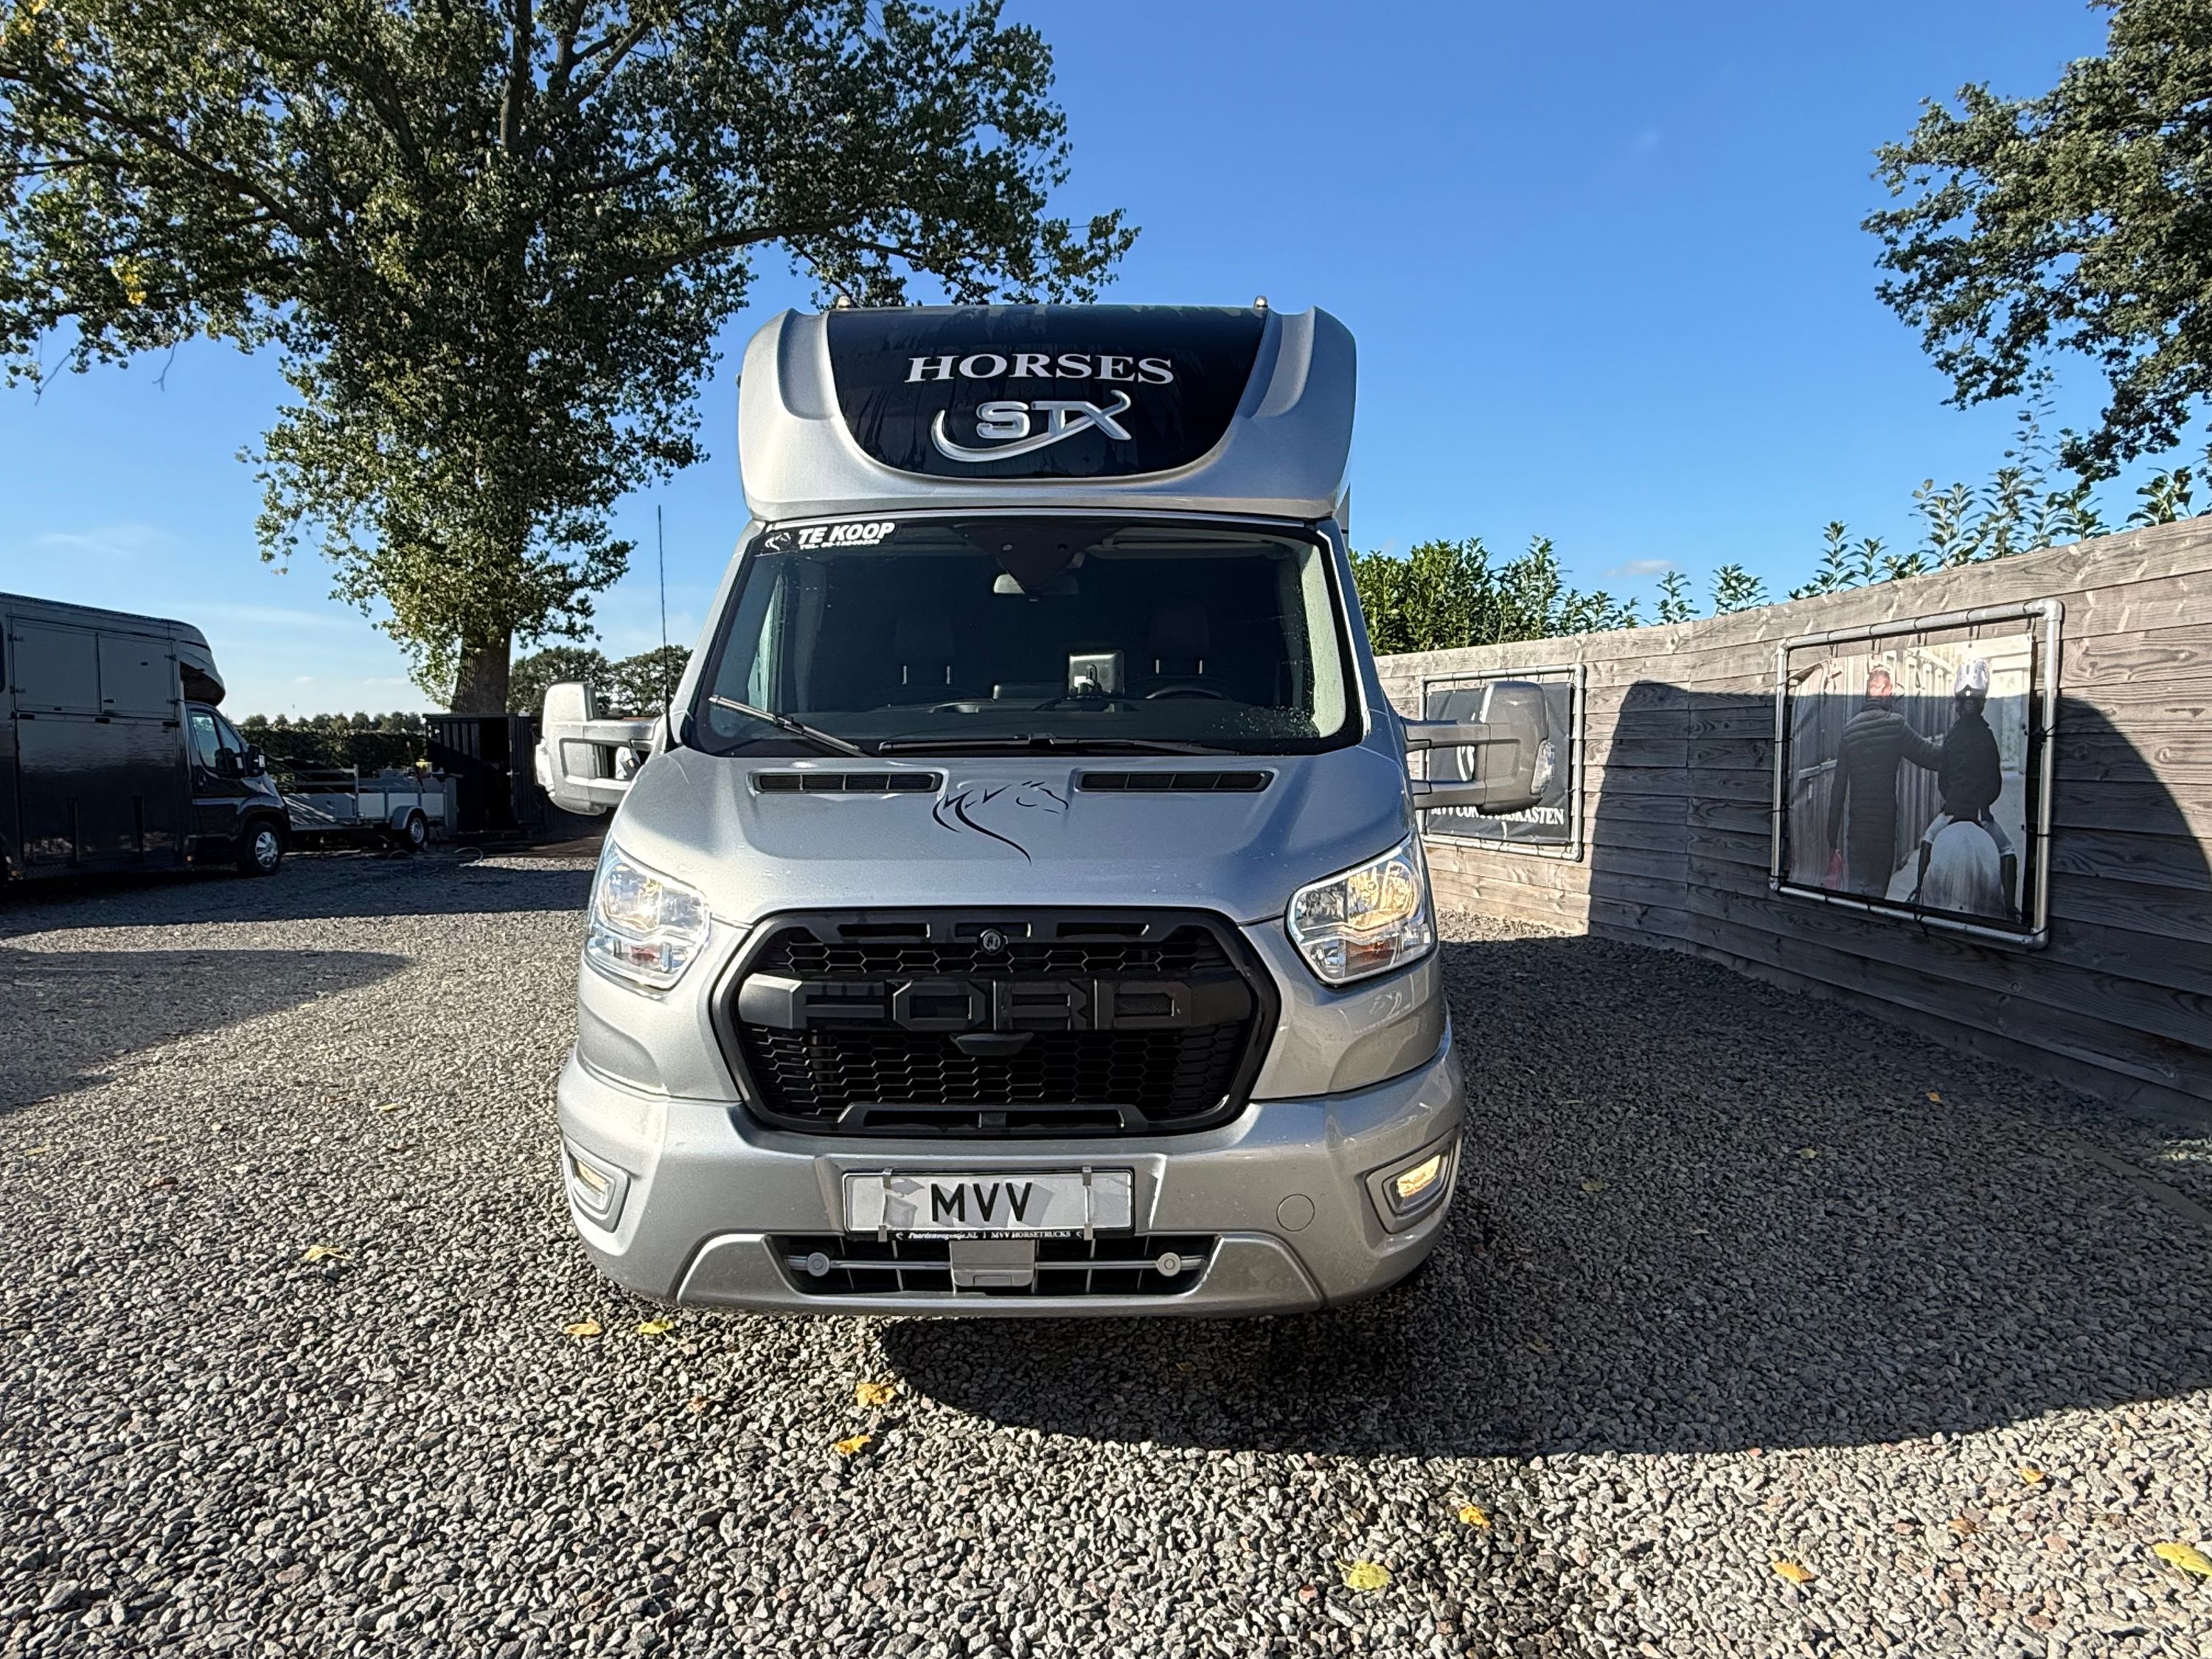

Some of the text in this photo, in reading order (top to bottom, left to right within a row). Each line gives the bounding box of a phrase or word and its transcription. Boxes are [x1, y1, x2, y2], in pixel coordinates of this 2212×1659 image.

[904, 353, 1174, 384] HORSES
[975, 389, 1133, 442] STX
[798, 526, 828, 546] TE
[829, 522, 895, 542] KOOP
[793, 979, 1192, 1031] FORD
[931, 1182, 1032, 1222] MVV
[1012, 1231, 1071, 1239] HORSETRUCKS
